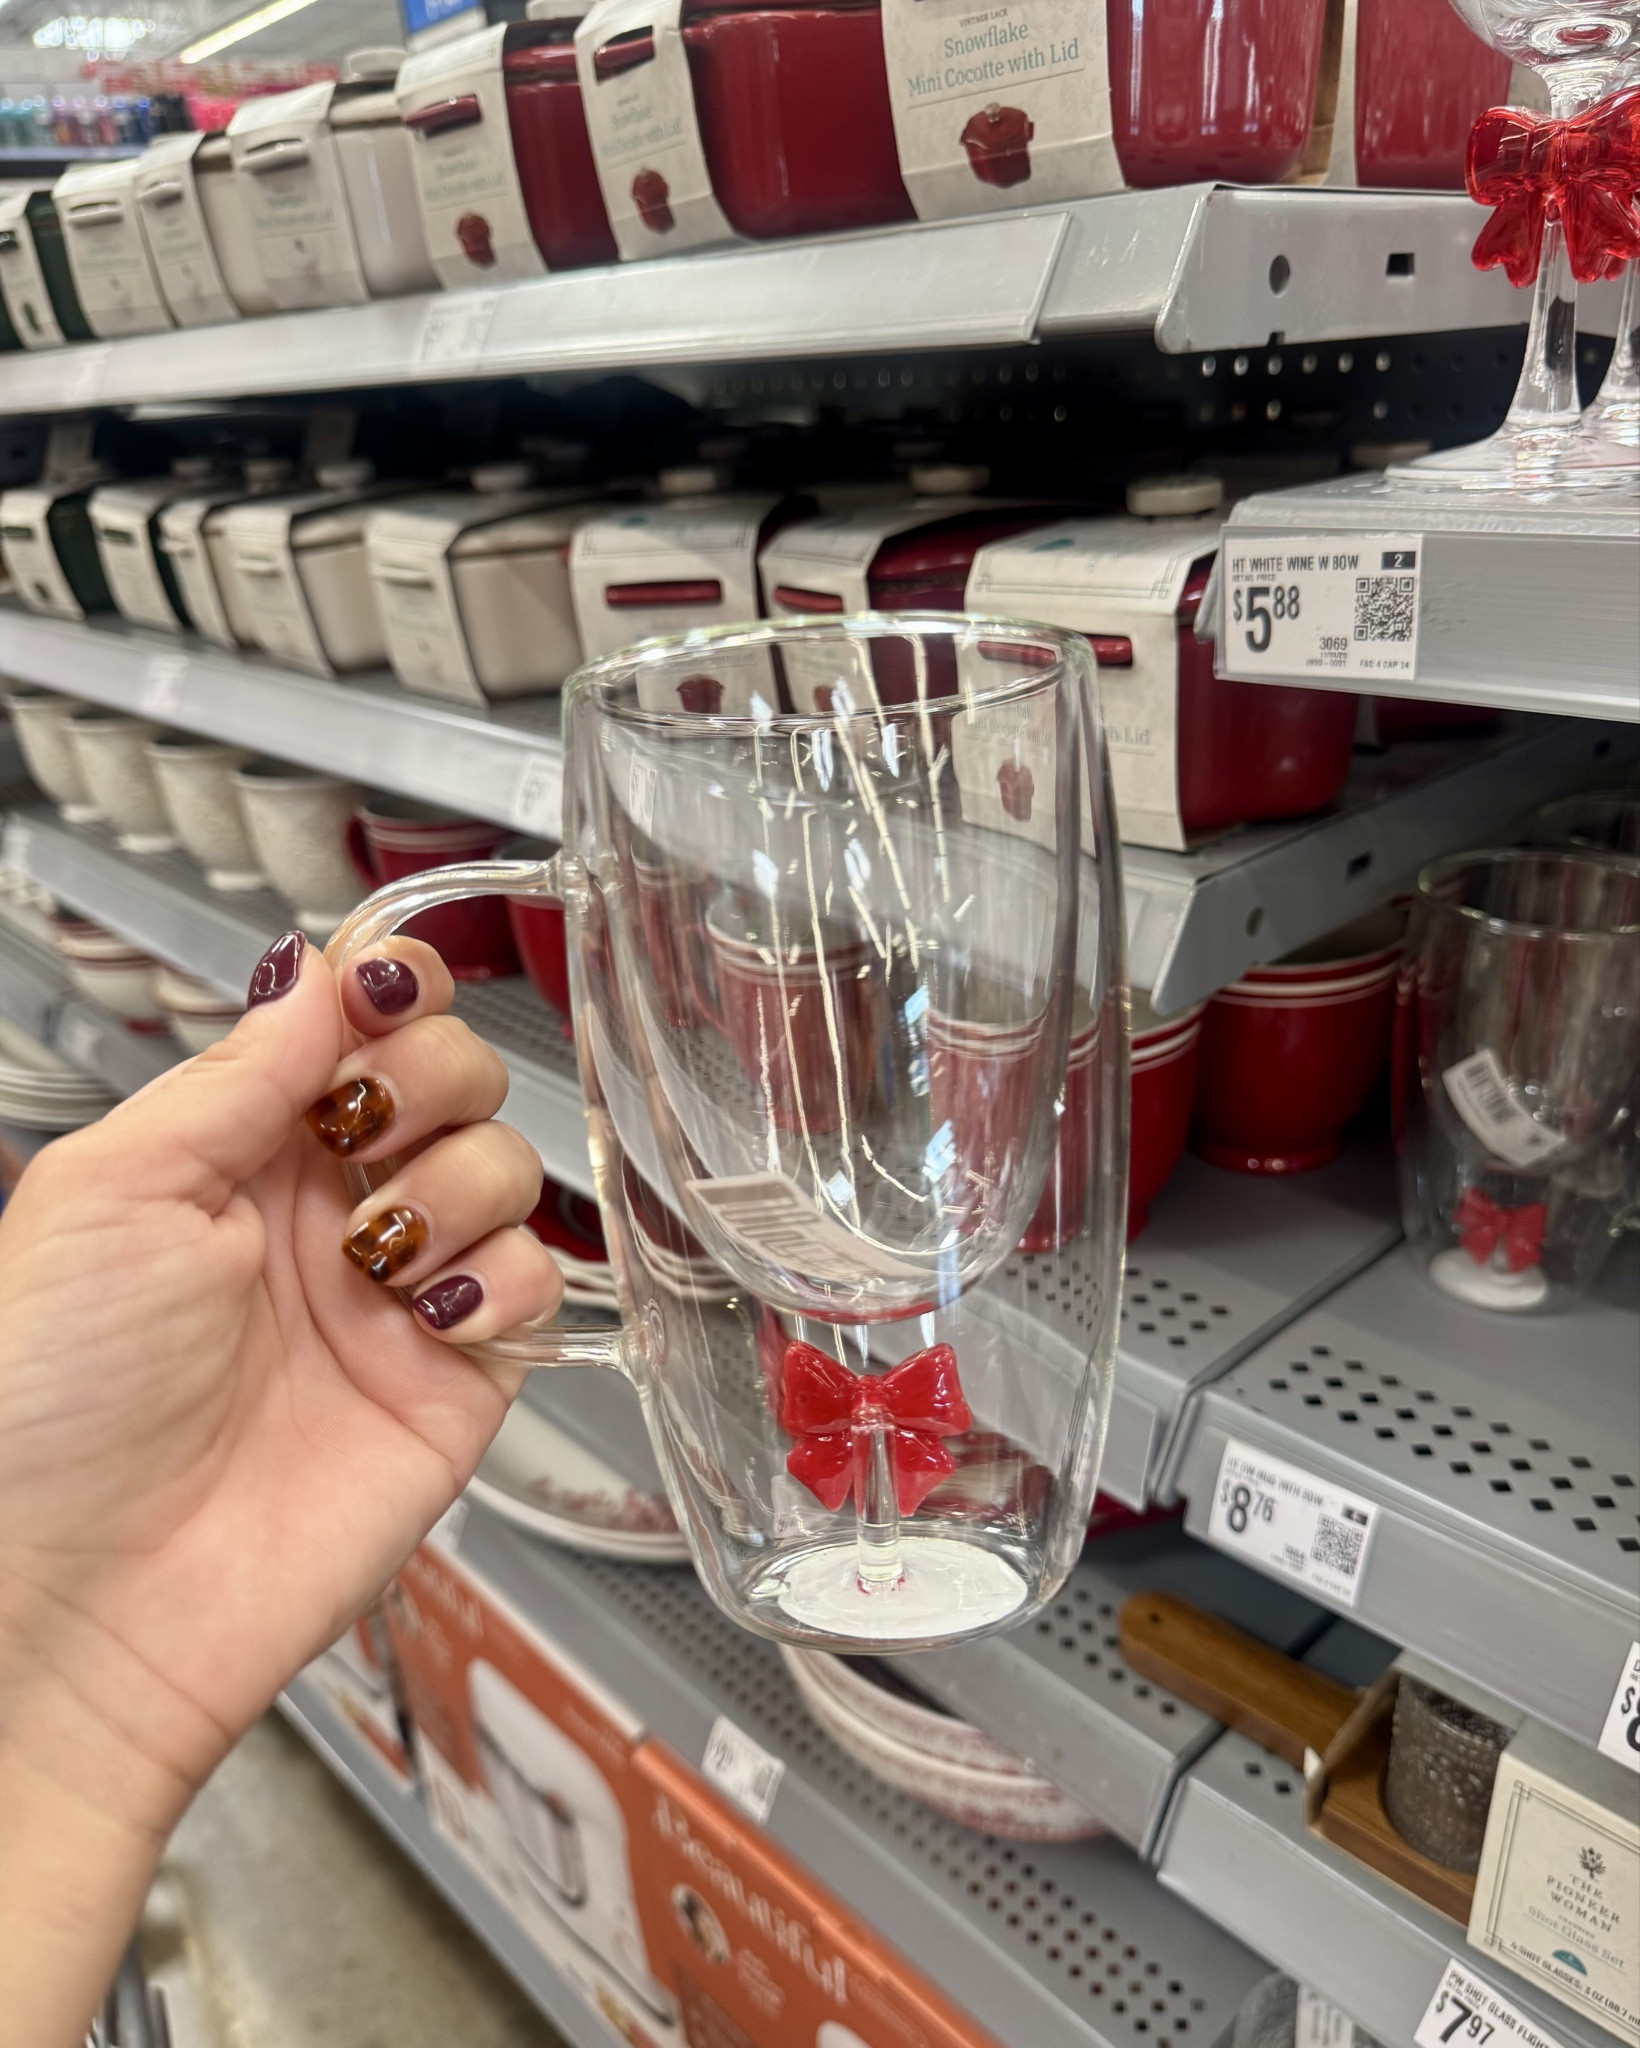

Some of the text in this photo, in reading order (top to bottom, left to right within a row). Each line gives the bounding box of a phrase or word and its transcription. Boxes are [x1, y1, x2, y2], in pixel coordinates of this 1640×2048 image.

[990, 8, 1008, 21] LACE
[944, 21, 1029, 58] Snowflake
[907, 39, 1079, 97] Mini Cocotte with Lid
[1232, 555, 1359, 572] HT WHITE WINE W BOW
[1394, 554, 1402, 567] 2
[1319, 637, 1348, 650] 3069
[1383, 661, 1398, 669] CAP
[1569, 1873, 1602, 1898] THE
[1547, 1875, 1620, 1923] PIONEER
[1551, 1891, 1612, 1932] WOMAN
[1465, 1982, 1488, 2005] SHOT
[1488, 2003, 1517, 2029] GLASS
